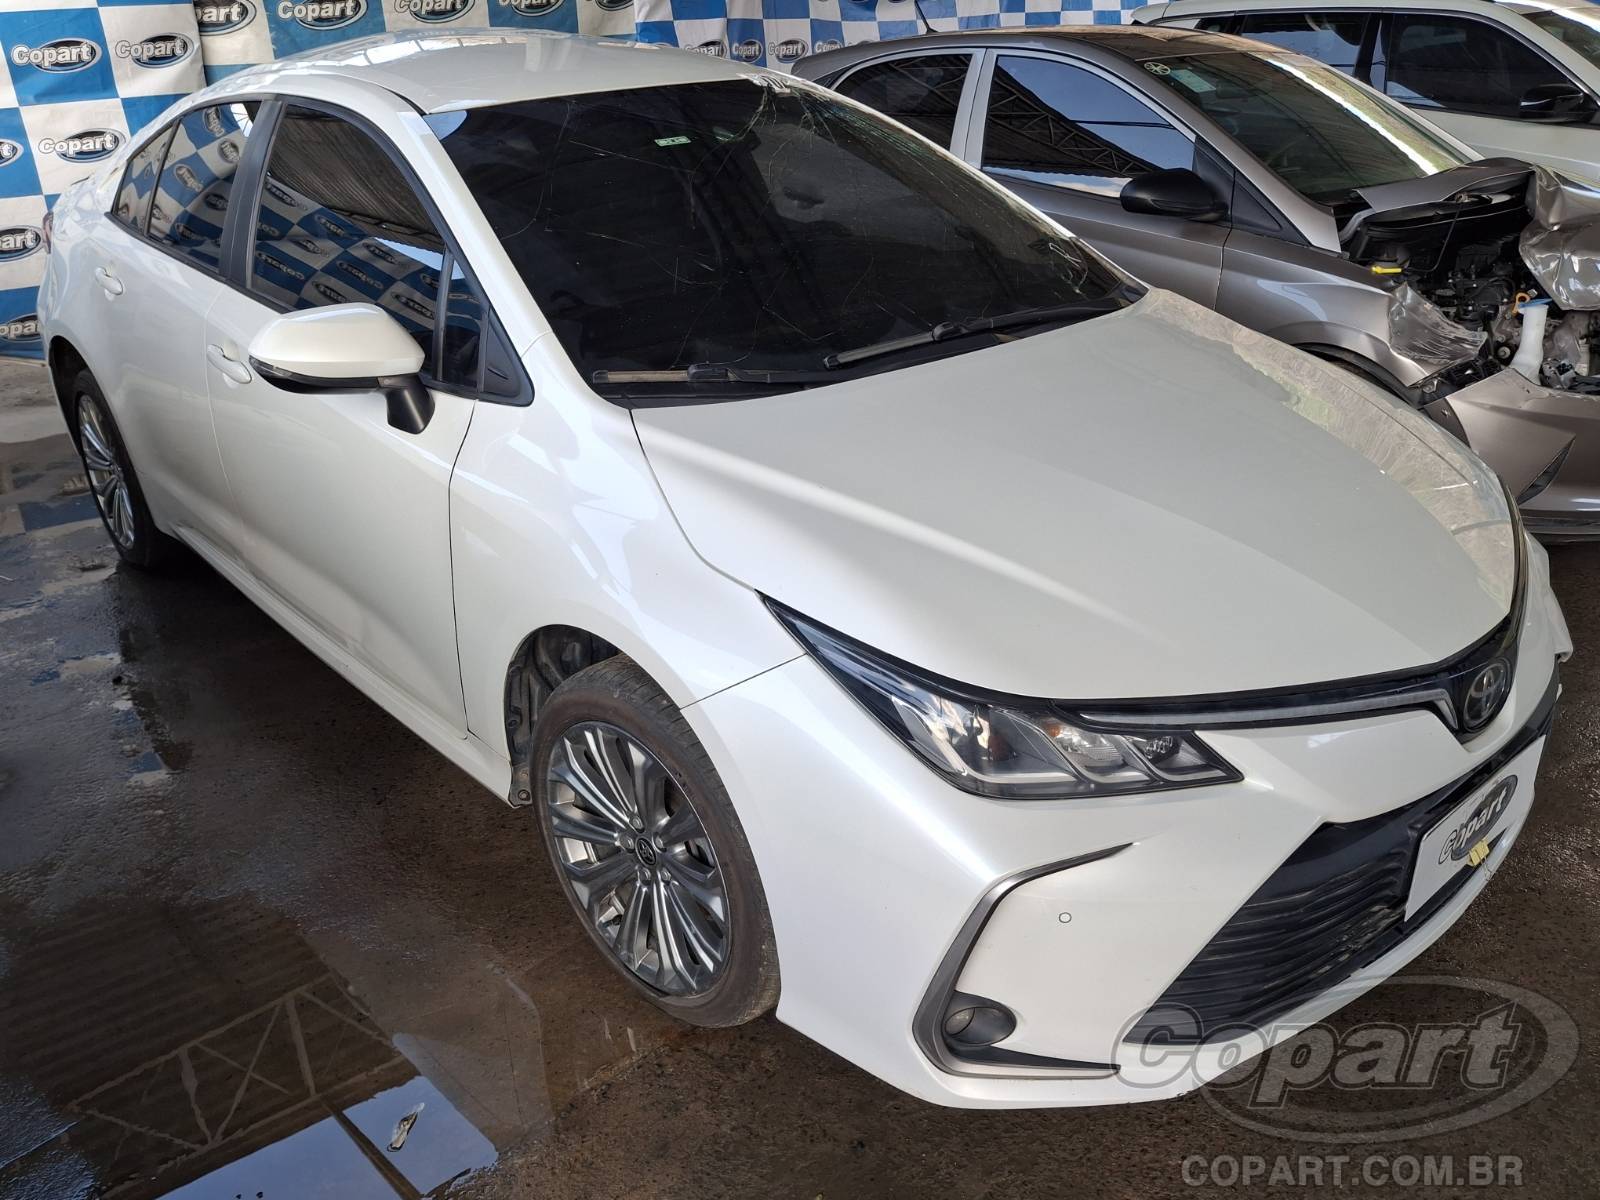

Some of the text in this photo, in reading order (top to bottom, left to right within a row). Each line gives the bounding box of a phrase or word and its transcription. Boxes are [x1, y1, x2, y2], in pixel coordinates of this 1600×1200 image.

[277, 0, 354, 22] Copart
[13, 42, 92, 68] Copart
[115, 36, 185, 61] Copart
[768, 42, 803, 58] Copart
[39, 132, 115, 156] Copart
[1438, 786, 1508, 865] Copart
